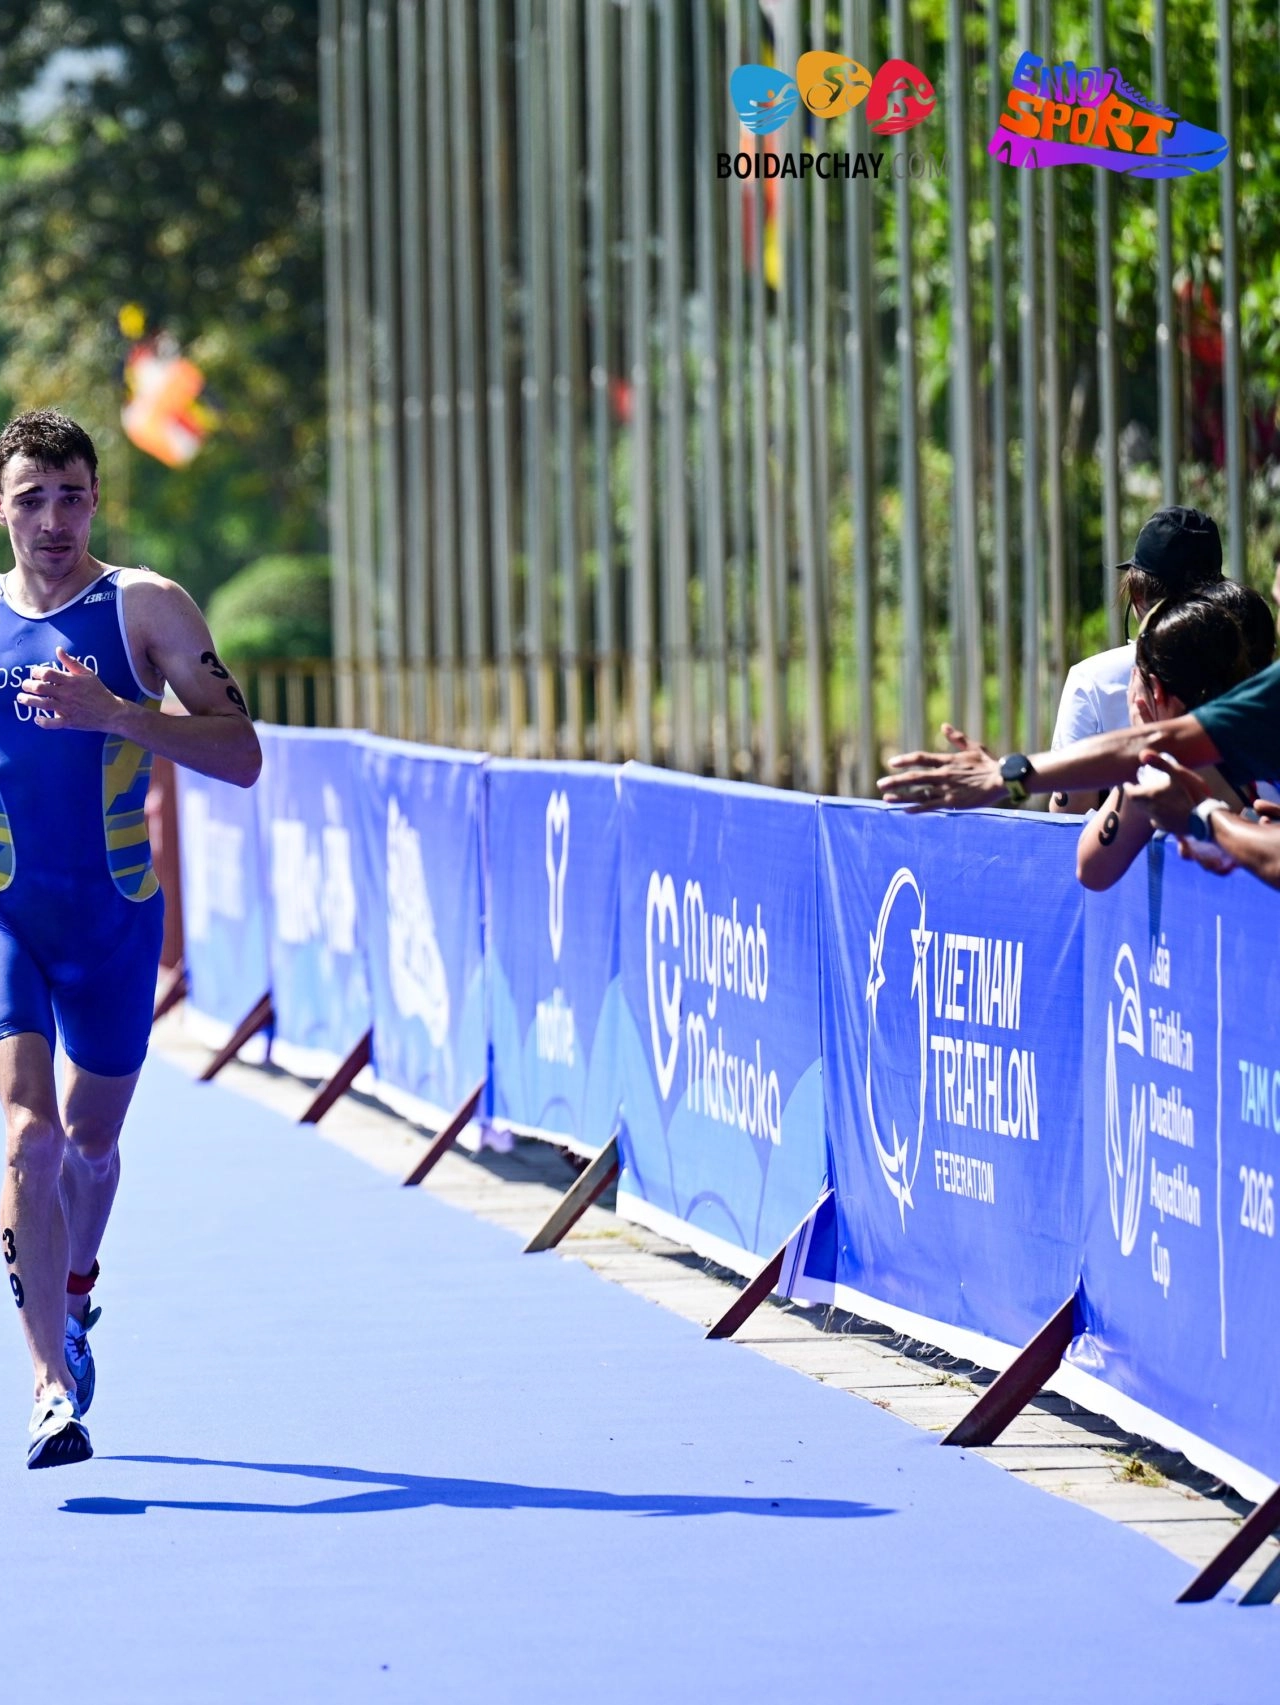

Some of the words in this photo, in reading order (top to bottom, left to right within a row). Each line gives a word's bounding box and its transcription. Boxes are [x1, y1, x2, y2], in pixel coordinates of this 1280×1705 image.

[683, 878, 769, 1019] Myrehab
[932, 931, 1024, 1030] VIETNAM
[1148, 931, 1171, 990] Asia
[1148, 1005, 1194, 1073] Triathlon
[686, 1011, 782, 1146] Matsuoka
[930, 1035, 1040, 1141] TRIATHLON
[1238, 1059, 1270, 1130] TAM
[1148, 1081, 1195, 1149] Duathlon
[933, 1149, 995, 1204] FEDERATION
[1149, 1156, 1201, 1228] Aquathlon
[1238, 1164, 1275, 1239] 2026
[2, 1227, 25, 1309] 39
[1150, 1230, 1171, 1299] Cup
